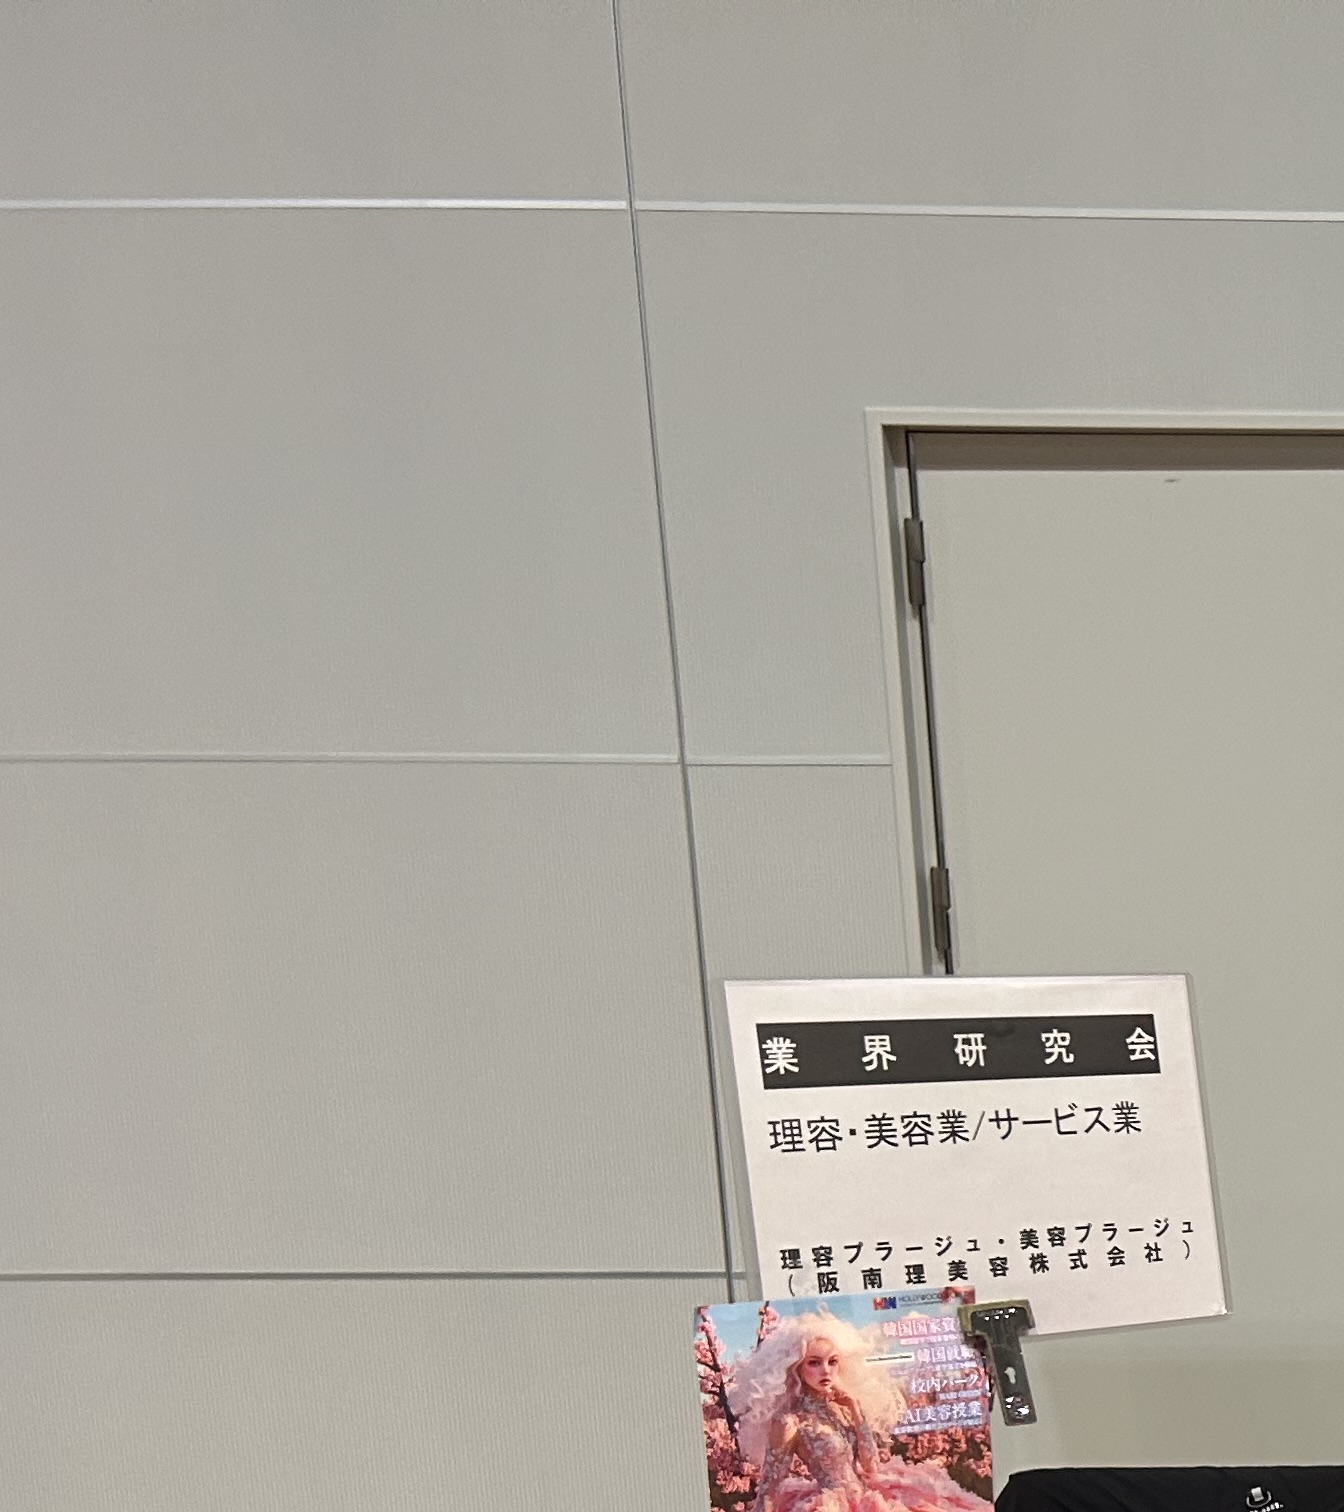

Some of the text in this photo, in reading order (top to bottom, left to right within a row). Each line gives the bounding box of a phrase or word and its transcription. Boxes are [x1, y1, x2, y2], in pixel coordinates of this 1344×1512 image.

[762, 1026, 1156, 1076] 業界研究会
